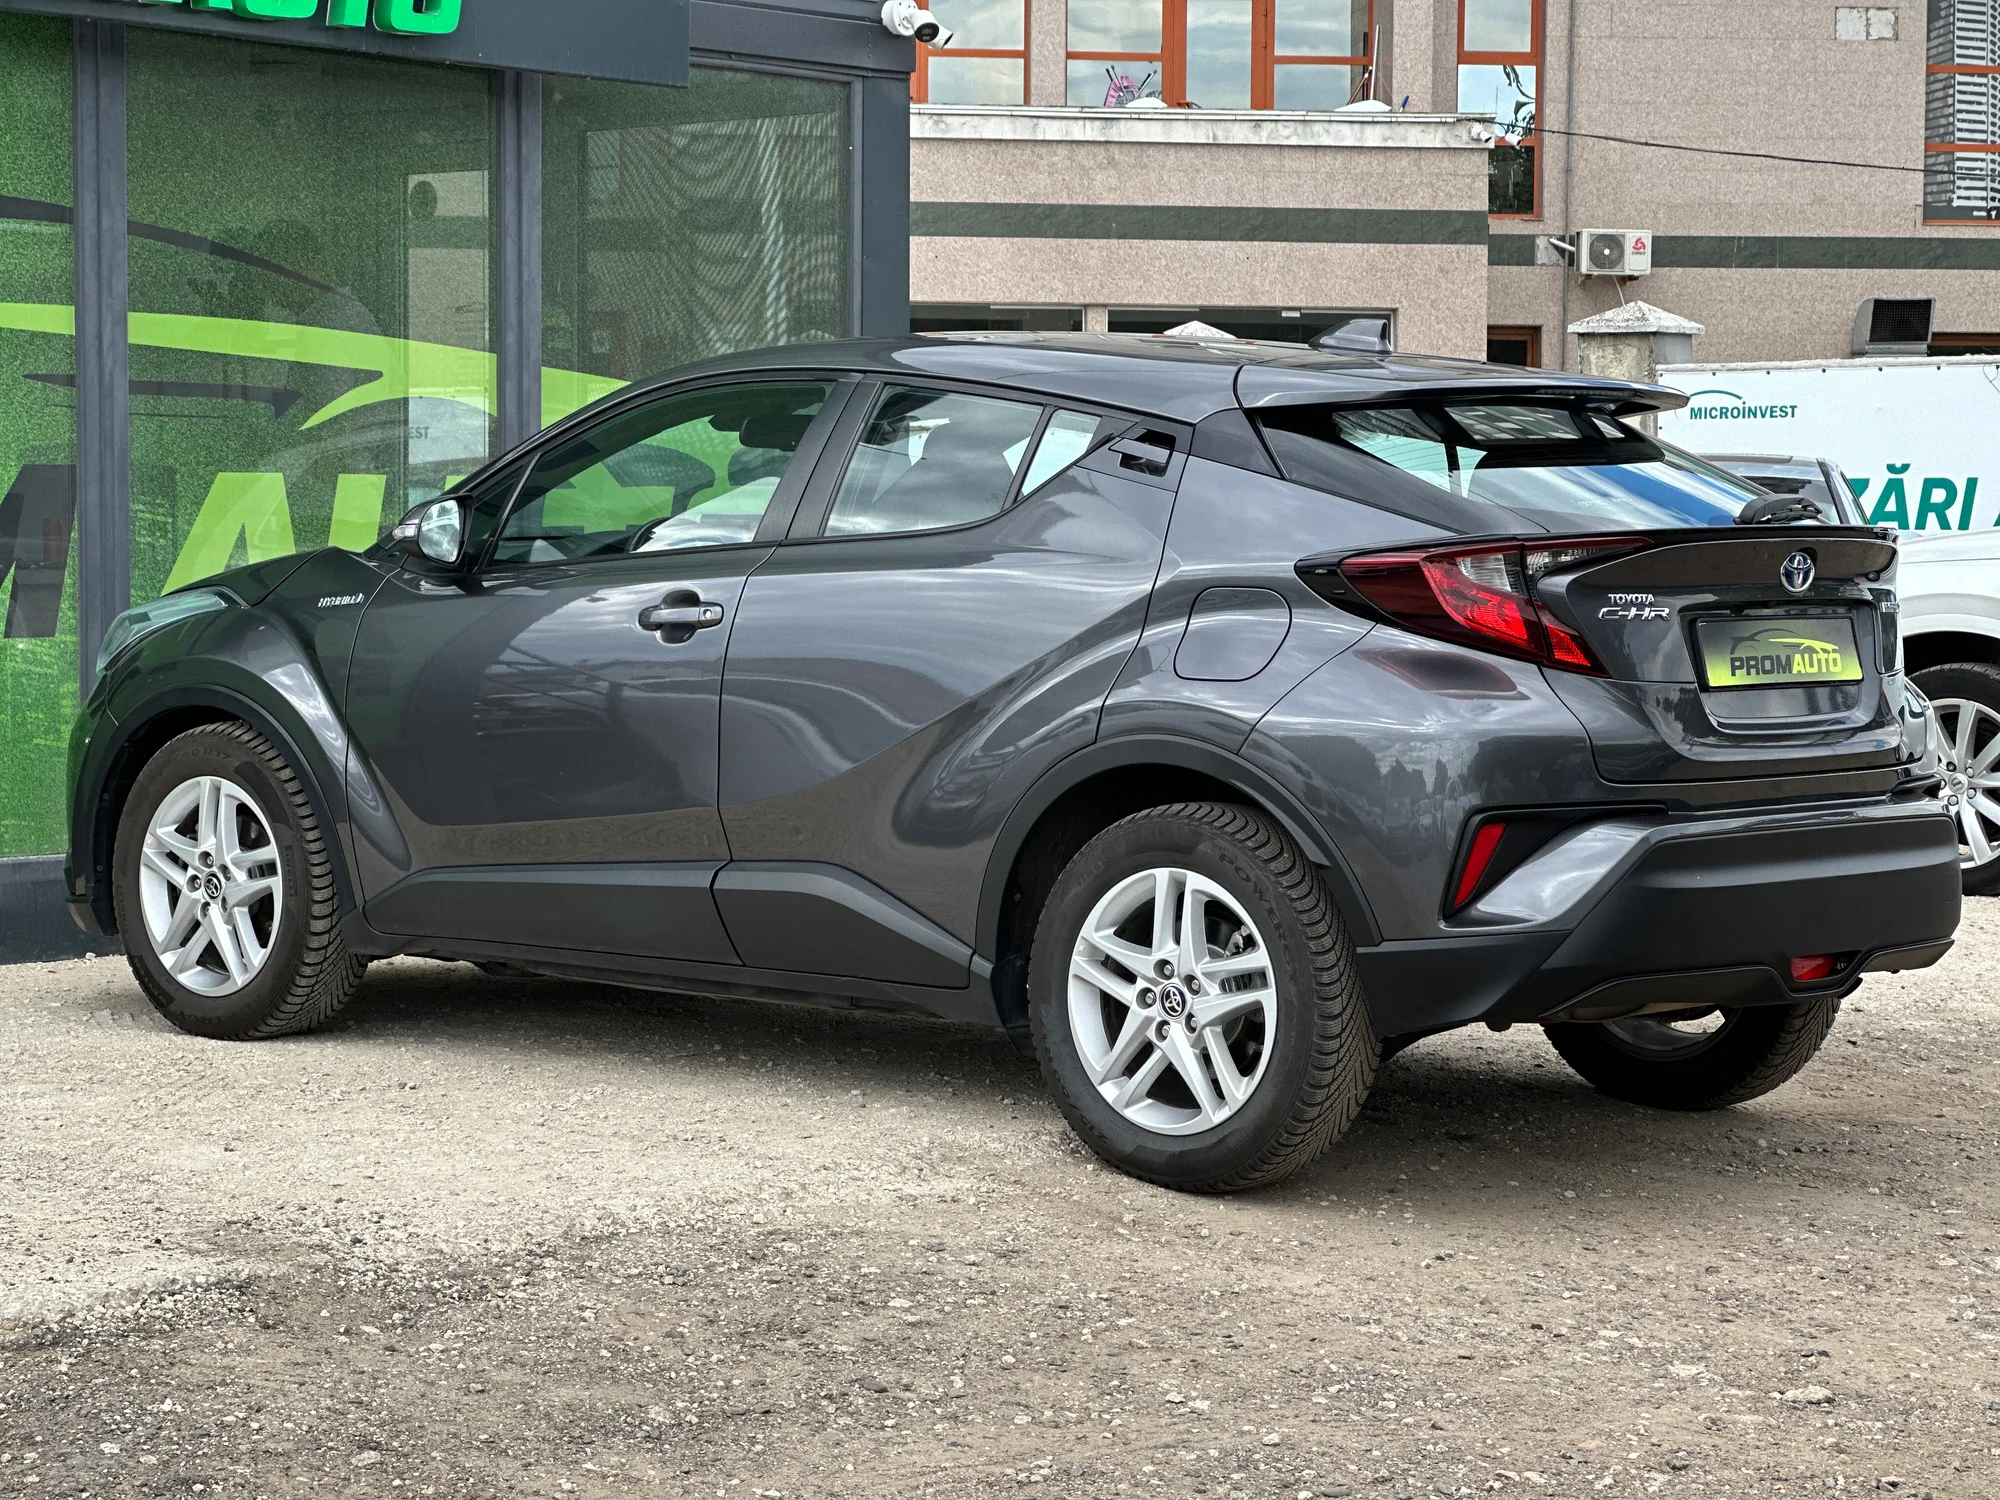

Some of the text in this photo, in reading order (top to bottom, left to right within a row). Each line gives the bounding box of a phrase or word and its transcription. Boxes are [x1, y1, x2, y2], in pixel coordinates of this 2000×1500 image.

[1607, 593, 1656, 605] TOYOTA
[1598, 606, 1670, 620] C-HR
[1729, 652, 1843, 677] PROMAUTO
